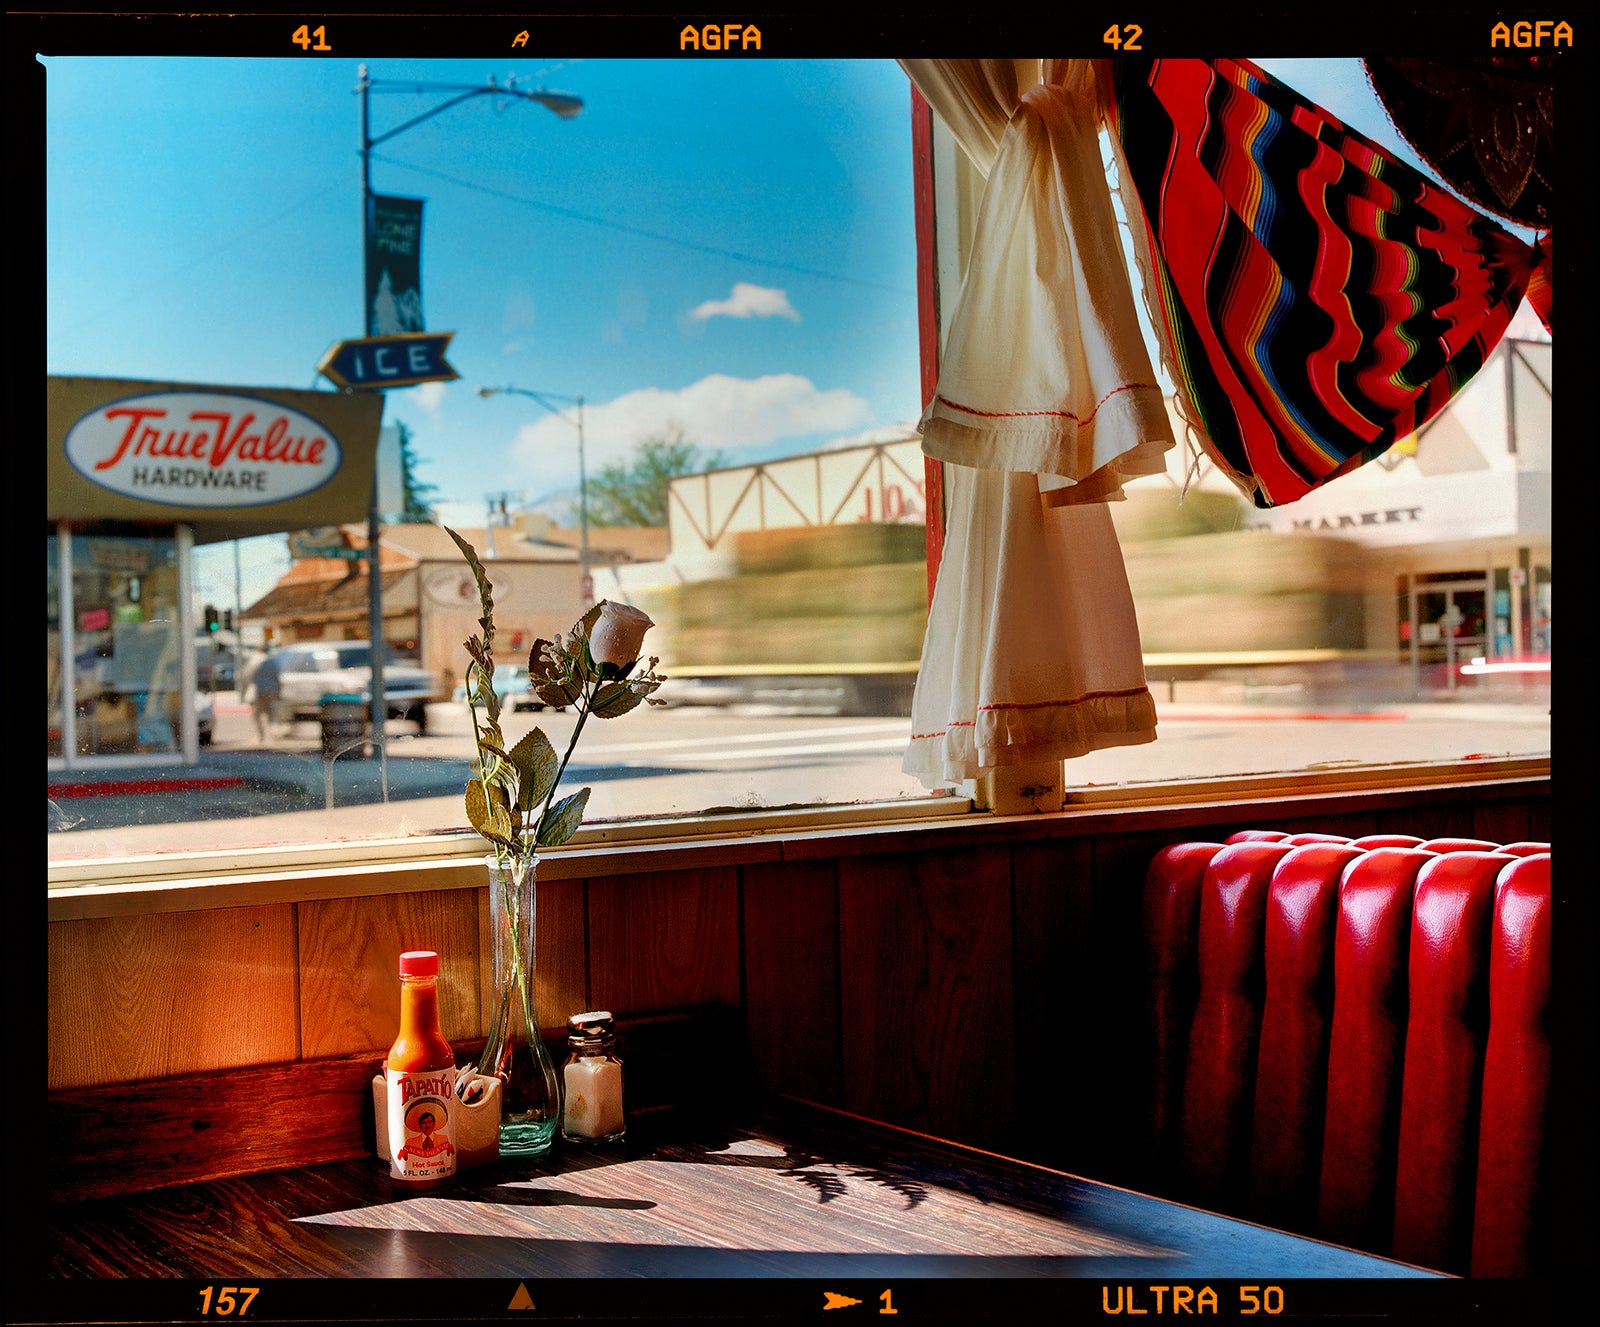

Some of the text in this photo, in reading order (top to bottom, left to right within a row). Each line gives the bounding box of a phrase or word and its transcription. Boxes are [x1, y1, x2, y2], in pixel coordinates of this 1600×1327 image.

[292, 25, 331, 51] 41
[680, 25, 761, 51] AGFA
[1104, 24, 1142, 51] 42
[1491, 21, 1573, 48] AGFA
[353, 345, 432, 378] ICE
[132, 466, 268, 492] HARDWARE
[1293, 507, 1422, 530] MARKET
[426, 1159, 445, 1168] Sauce
[200, 1286, 260, 1316] 157
[880, 1288, 898, 1315] 1
[1103, 1285, 1284, 1315] ULTRA 50
